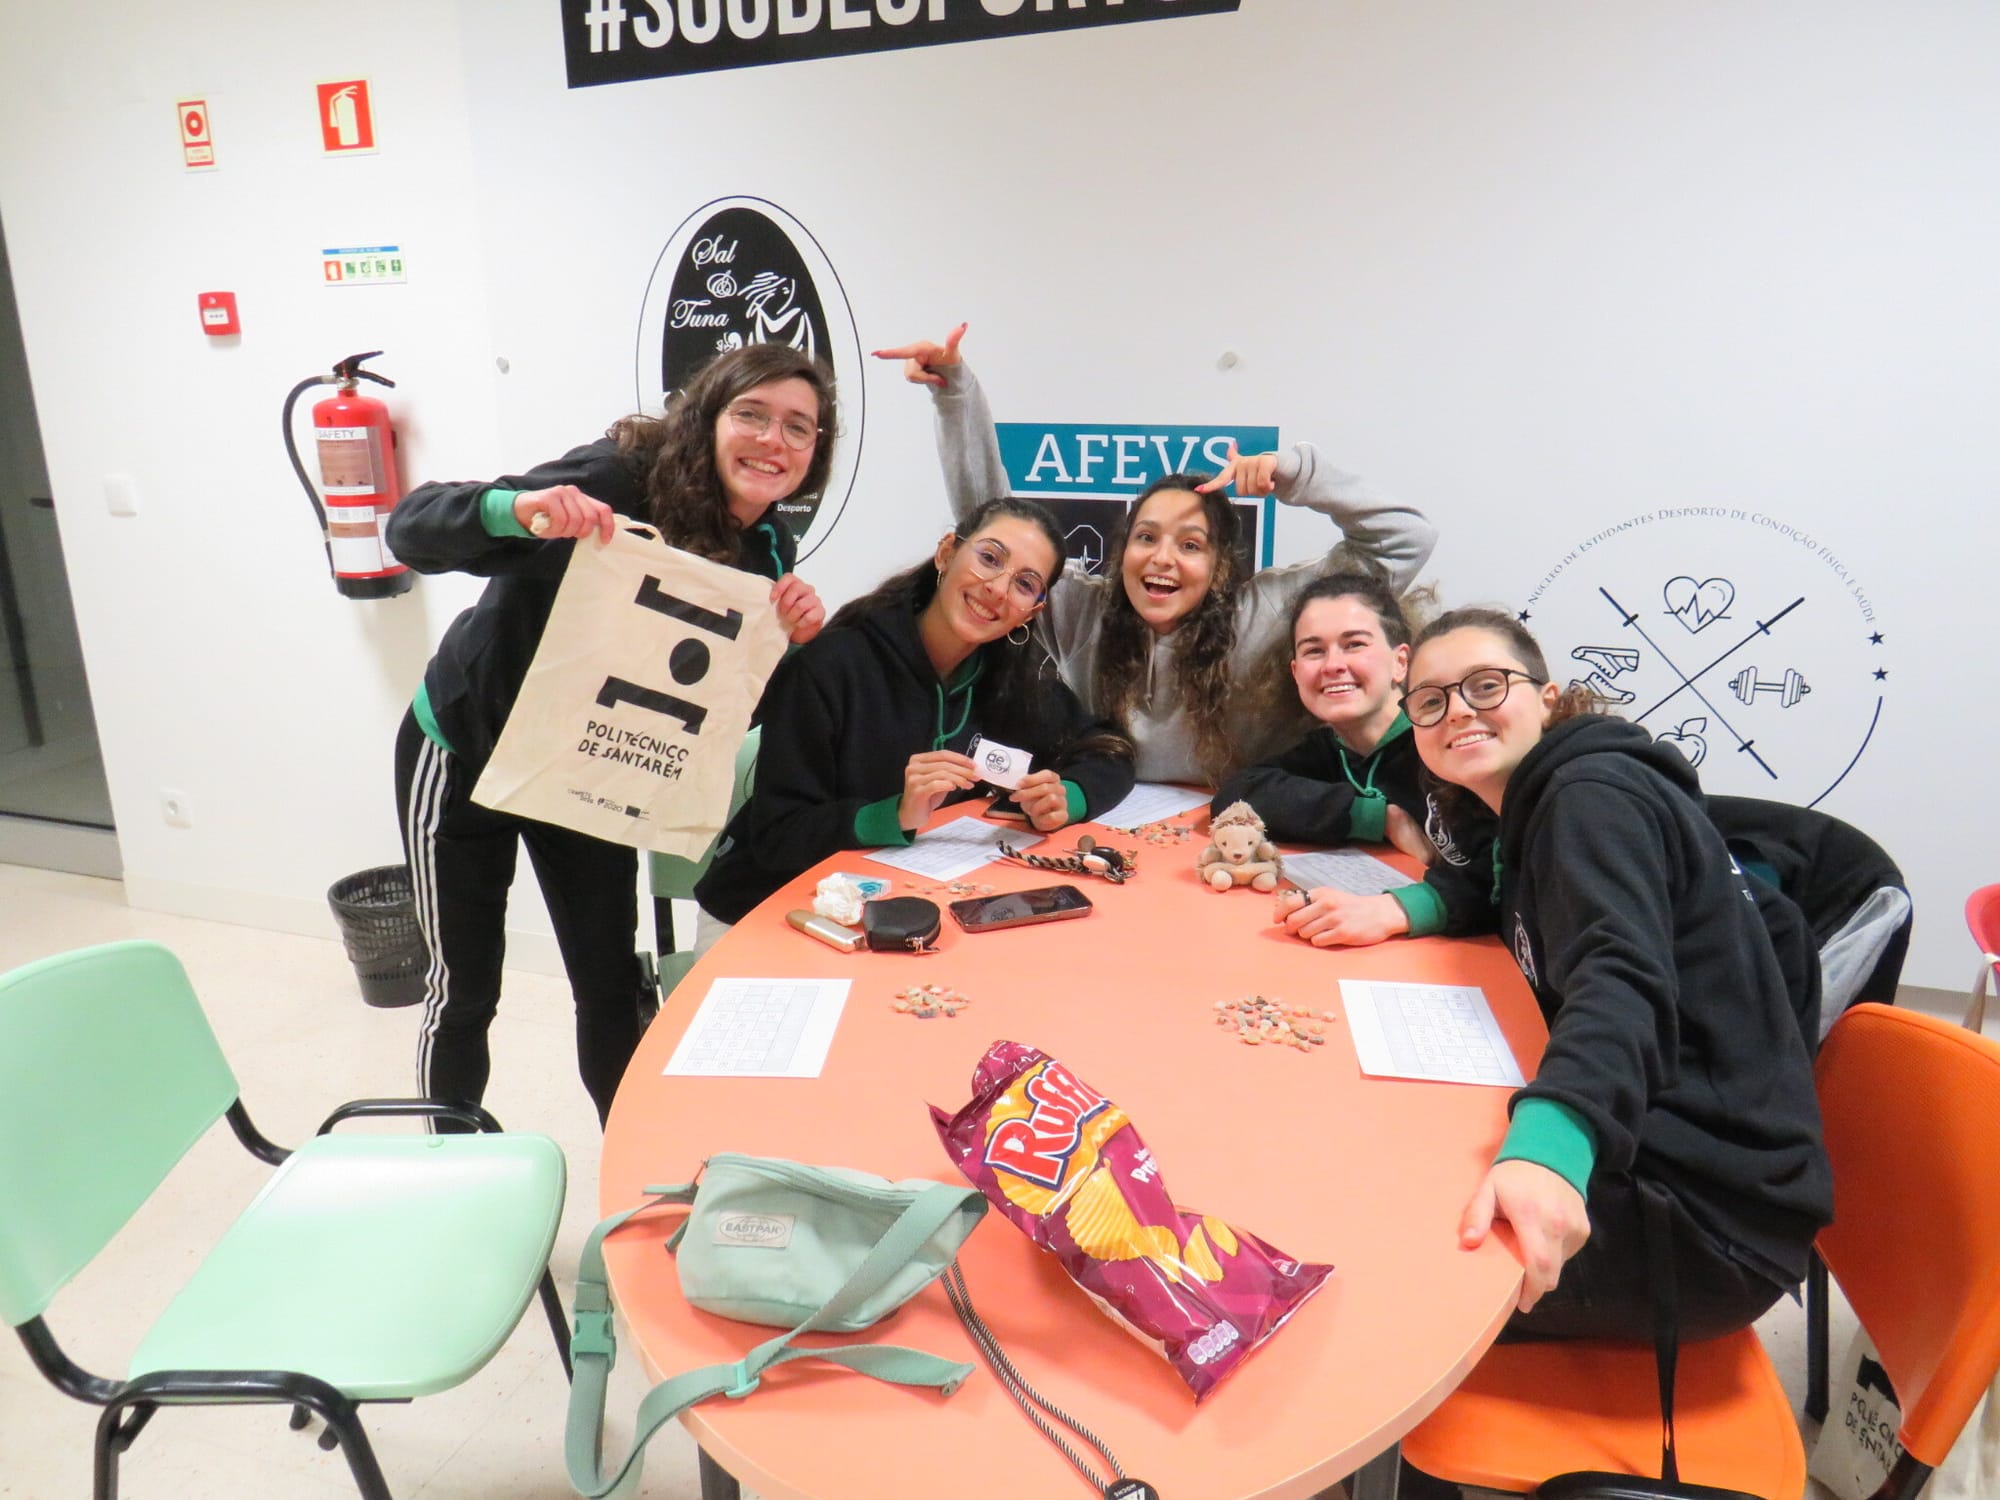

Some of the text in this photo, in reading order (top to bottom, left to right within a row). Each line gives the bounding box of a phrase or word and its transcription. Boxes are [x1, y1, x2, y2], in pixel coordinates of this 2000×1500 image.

[692, 234, 739, 270] Sal
[670, 299, 730, 329] Tuna
[1024, 433, 1237, 487] AFEVS
[777, 503, 812, 514] Desporto
[1563, 550, 1578, 566] DE
[1578, 513, 1654, 553] ESTUDANTES
[1658, 507, 1726, 520] DESPORTO
[1730, 510, 1747, 521] DE
[1751, 513, 1817, 550] CONDIÇÃO
[577, 739, 683, 780] DE SANTARÉM
[586, 720, 689, 762] POLITÉCNICO
[984, 1061, 1109, 1187] Ruffl
[725, 1223, 779, 1234] EASTPAK
